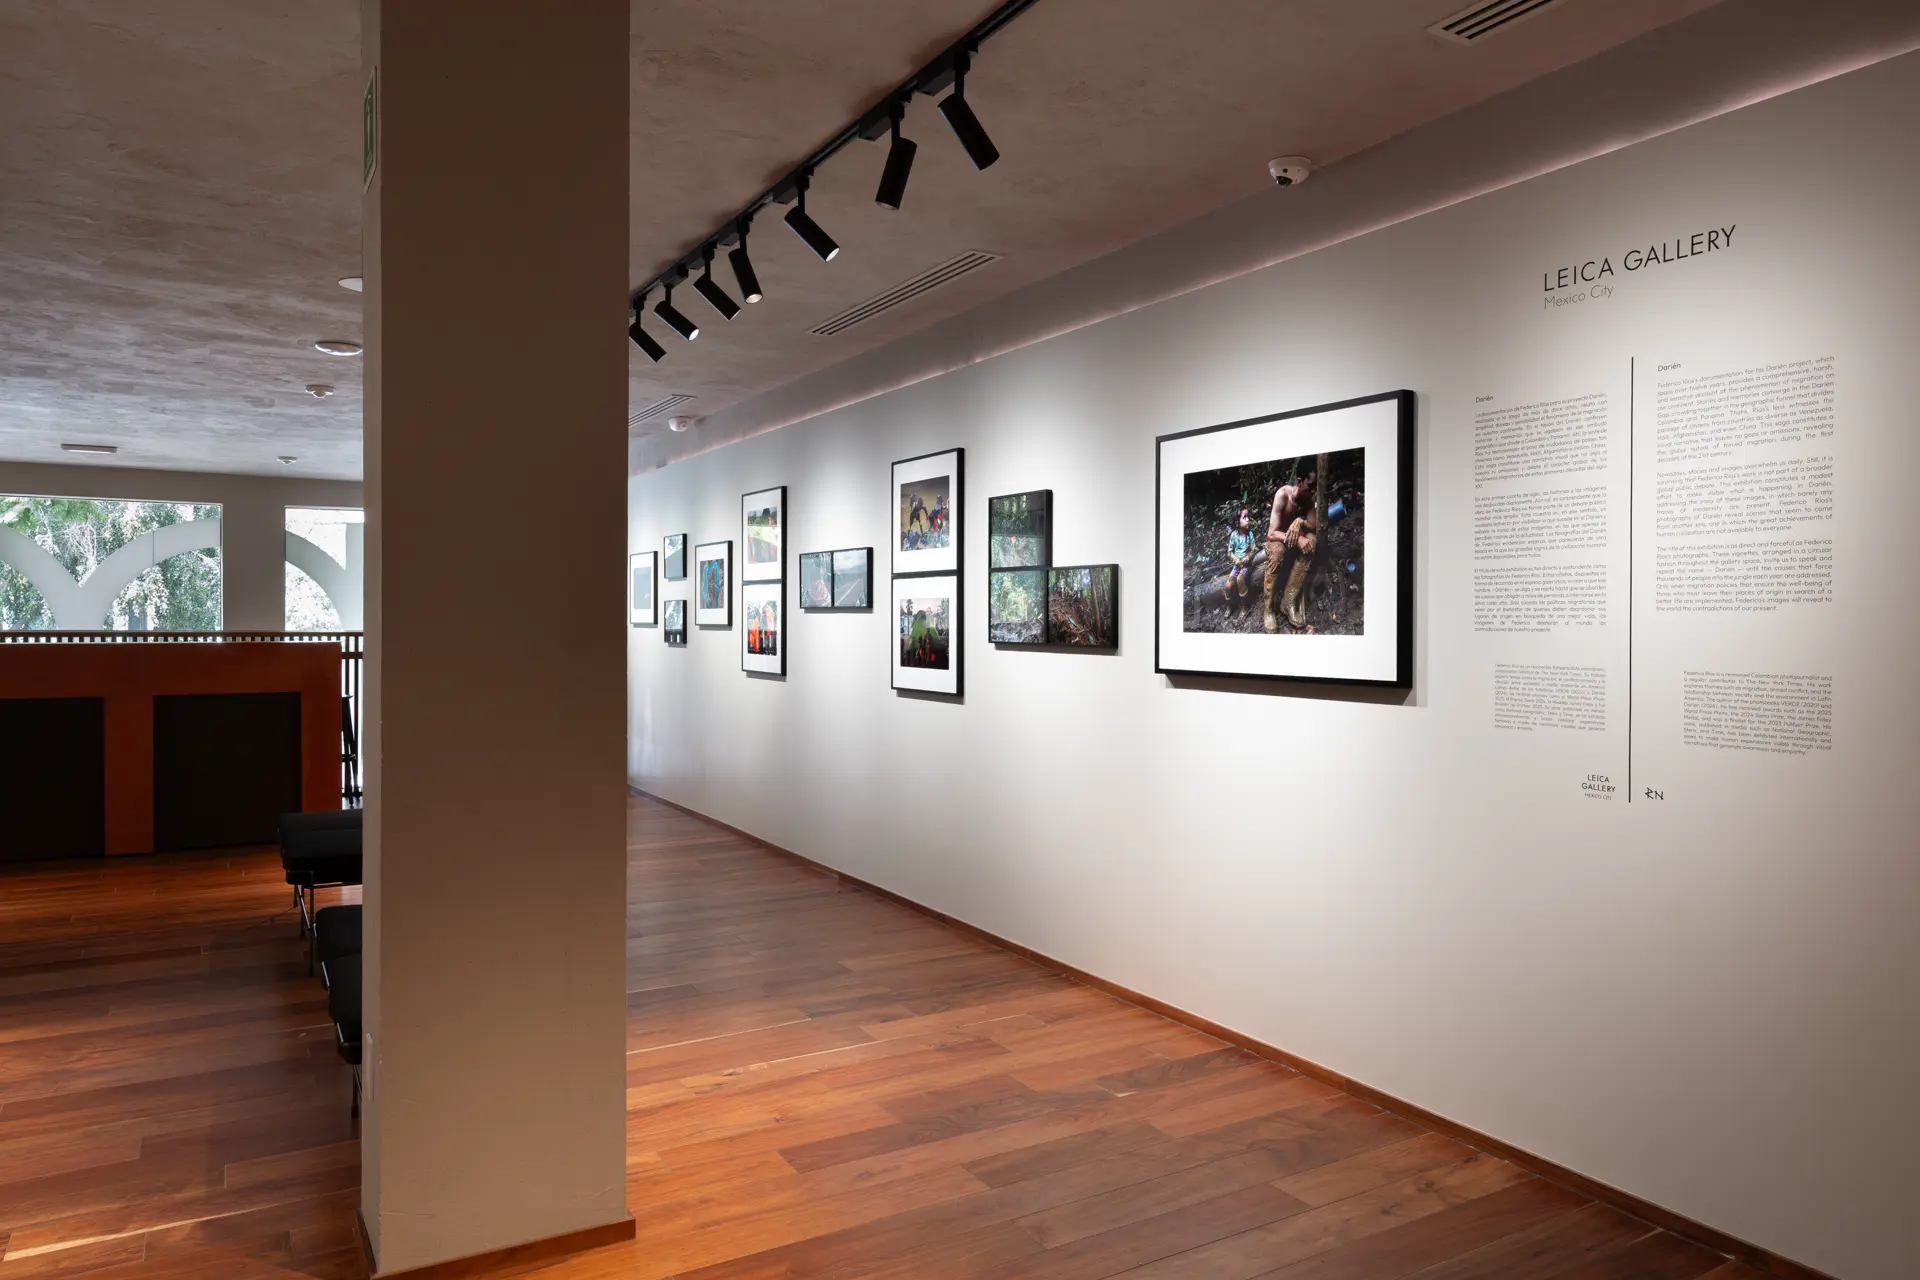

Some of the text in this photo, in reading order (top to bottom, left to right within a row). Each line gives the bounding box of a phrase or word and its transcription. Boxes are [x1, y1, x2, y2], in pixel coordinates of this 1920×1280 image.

[1544, 224, 1737, 292] LEICA GALLERY
[1544, 283, 1614, 310] Mexico City
[1657, 362, 1681, 372] Darién
[1765, 362, 1787, 371] Darién
[1814, 355, 1834, 364] which
[1791, 373, 1823, 385] migration
[1761, 387, 1789, 397] converge
[1811, 380, 1834, 389] Darién
[1475, 394, 1494, 404] Darién
[1776, 394, 1795, 402] funnel
[1810, 388, 1833, 398] divides
[1788, 399, 1819, 408] witnesses
[1764, 411, 1787, 420] diverse
[1774, 420, 1790, 428] saga
[1792, 414, 1827, 424] constitutes
[1803, 422, 1833, 433] revealing
[1746, 436, 1776, 447] migration
[1780, 434, 1800, 443] during
[1744, 460, 1777, 469] overwhelm
[1775, 467, 1789, 476] part
[1805, 464, 1832, 472] broader
[1764, 475, 1798, 483] constitutes
[1808, 472, 1832, 480] modest
[1758, 483, 1792, 493] happening
[1797, 489, 1818, 498] barely
[1759, 516, 1776, 525] great
[1778, 514, 1823, 522] achievements
[1761, 548, 1791, 556] arranged
[1587, 774, 1609, 783] LEICA
[1581, 783, 1616, 793] GALLERY
